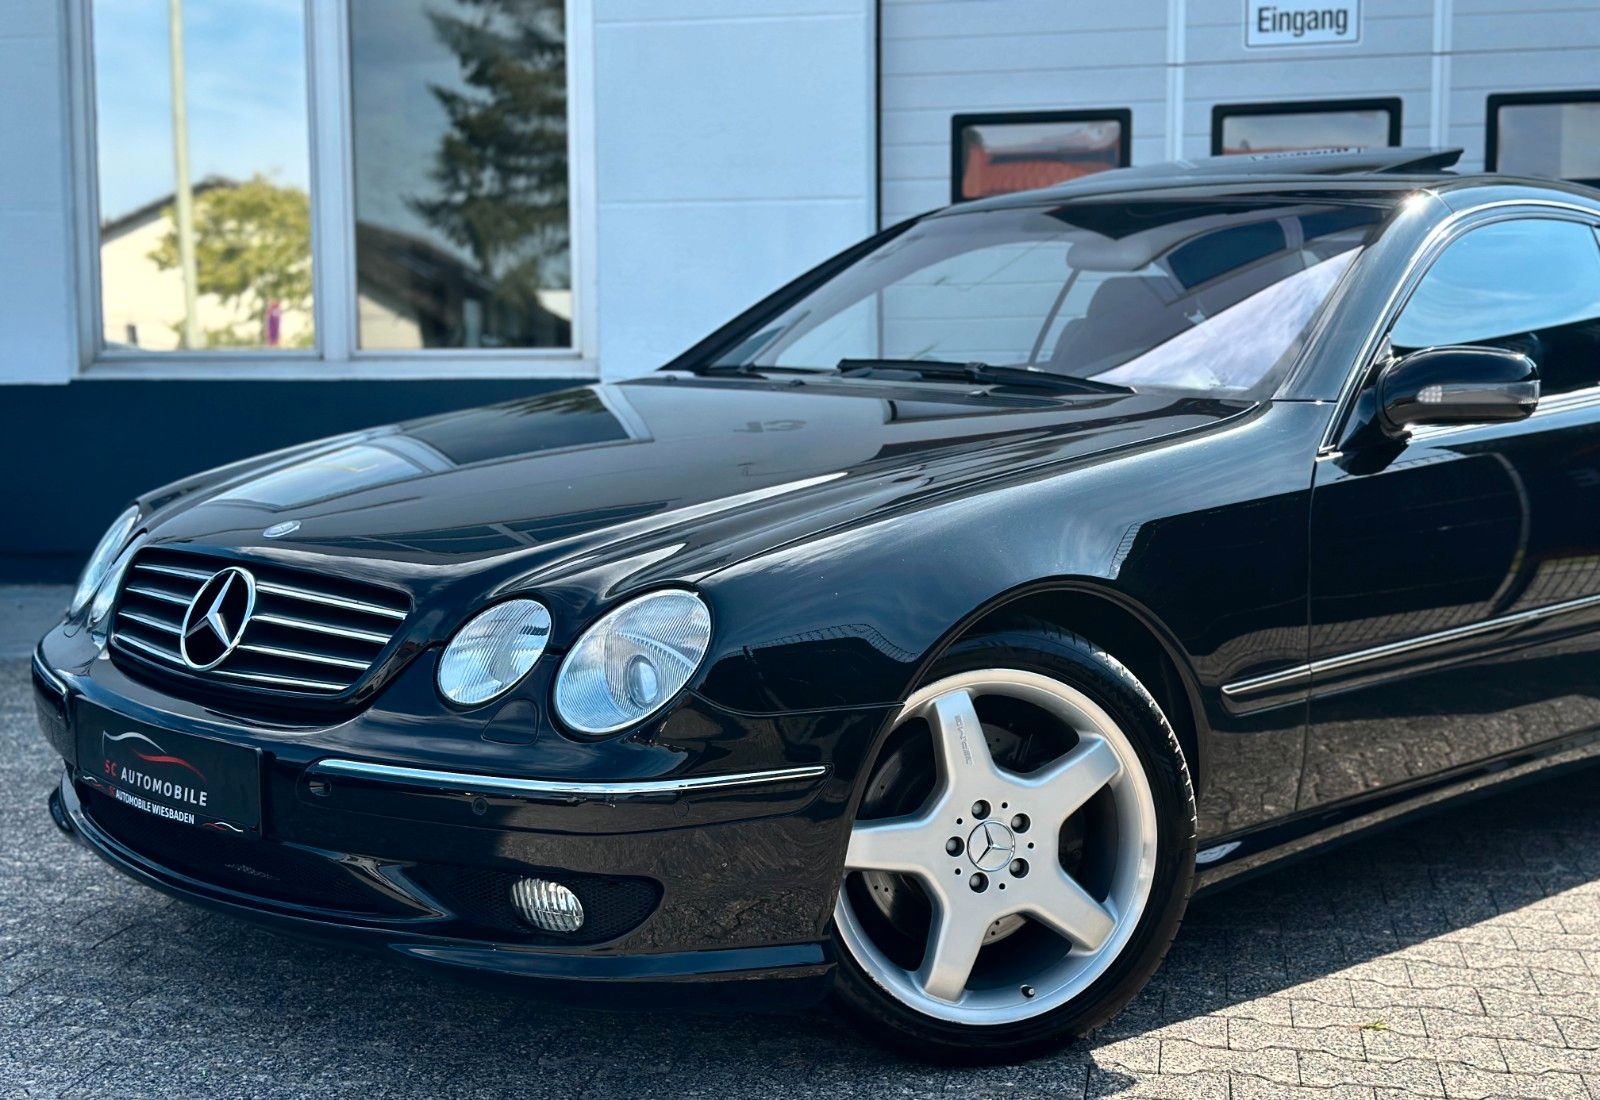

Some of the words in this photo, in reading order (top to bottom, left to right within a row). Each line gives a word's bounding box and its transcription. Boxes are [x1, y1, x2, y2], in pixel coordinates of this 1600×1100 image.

[1258, 6, 1348, 38] Eingang
[104, 759, 117, 776] SC
[120, 766, 208, 807] AUTOMOBILE
[115, 789, 152, 813] AUTOMOBILE
[152, 802, 195, 825] WIESBADEN
